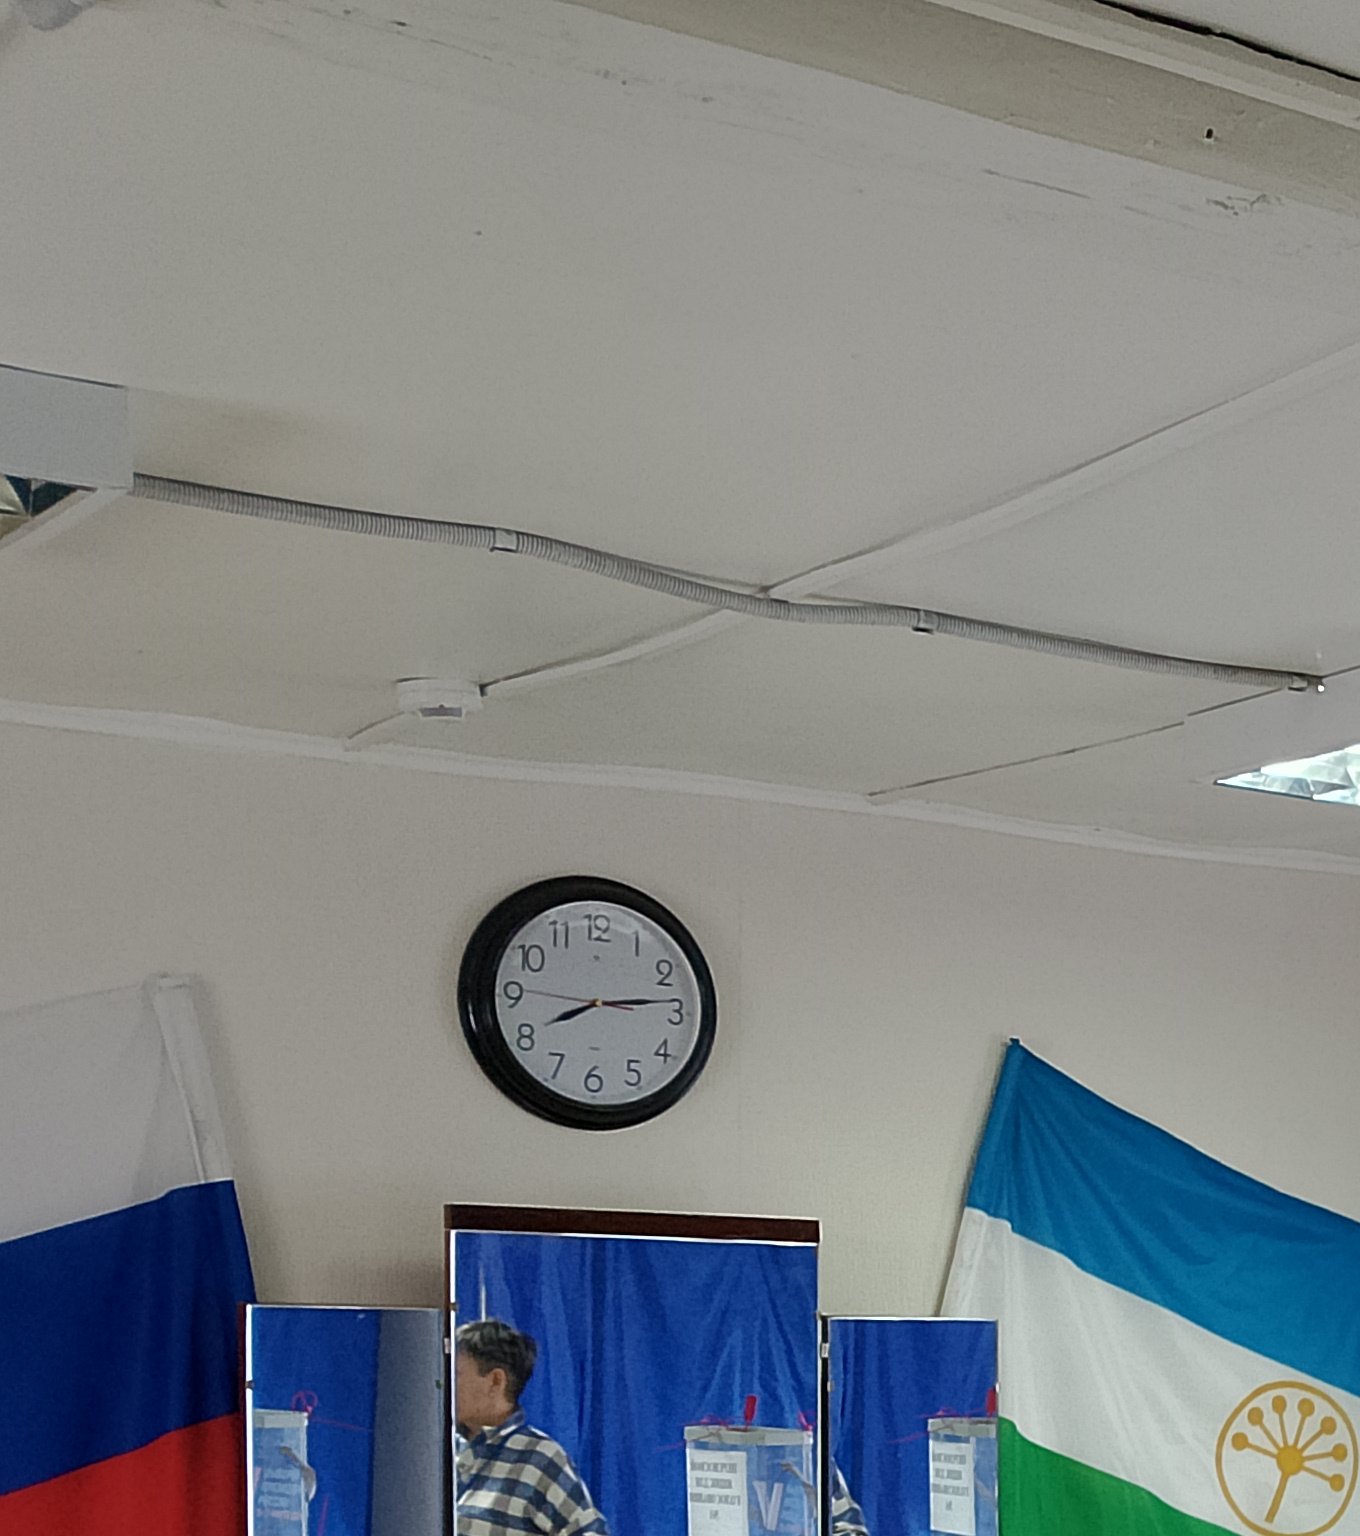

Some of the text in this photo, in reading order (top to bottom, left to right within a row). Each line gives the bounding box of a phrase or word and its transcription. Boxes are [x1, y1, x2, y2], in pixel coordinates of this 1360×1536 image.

[548, 920, 570, 949] 11
[583, 914, 612, 943] 12
[518, 944, 545, 972] 10
[631, 931, 640, 957] 1
[655, 959, 674, 987] 2
[503, 980, 524, 1009] 9
[666, 998, 684, 1026] 3
[516, 1023, 535, 1051] 8
[653, 1038, 672, 1064] 4
[547, 1052, 566, 1080] 7
[583, 1065, 604, 1093] 6
[623, 1059, 642, 1087] 5
